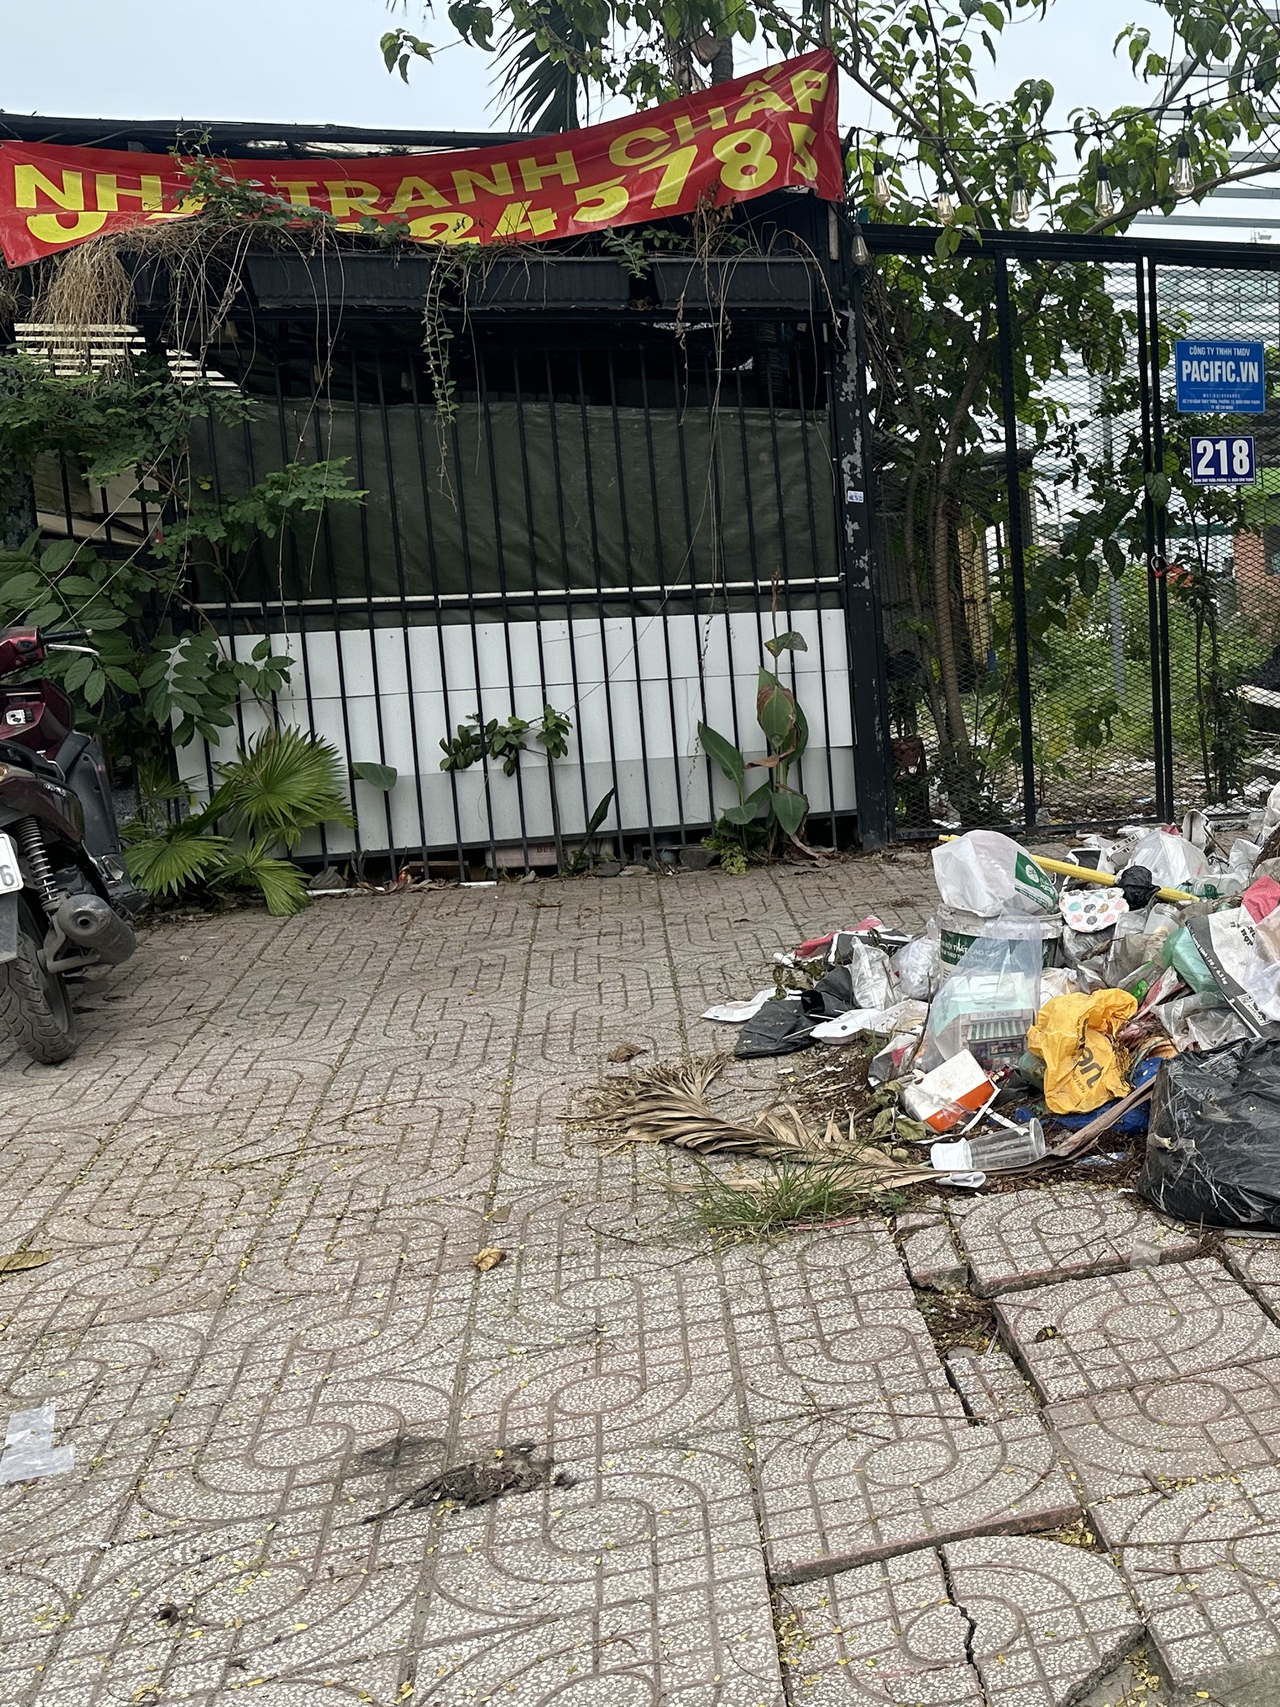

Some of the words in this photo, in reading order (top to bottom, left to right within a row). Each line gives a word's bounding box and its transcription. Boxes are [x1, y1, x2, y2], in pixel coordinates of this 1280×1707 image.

[272, 150, 580, 217] TRANH
[608, 64, 829, 167] CHẤP
[1189, 345, 1206, 356] CÔNG
[1207, 347, 1215, 356] TY
[1216, 347, 1233, 356] TNHH
[1182, 360, 1259, 383] PACIFIC.VN
[1196, 439, 1250, 476] 218
